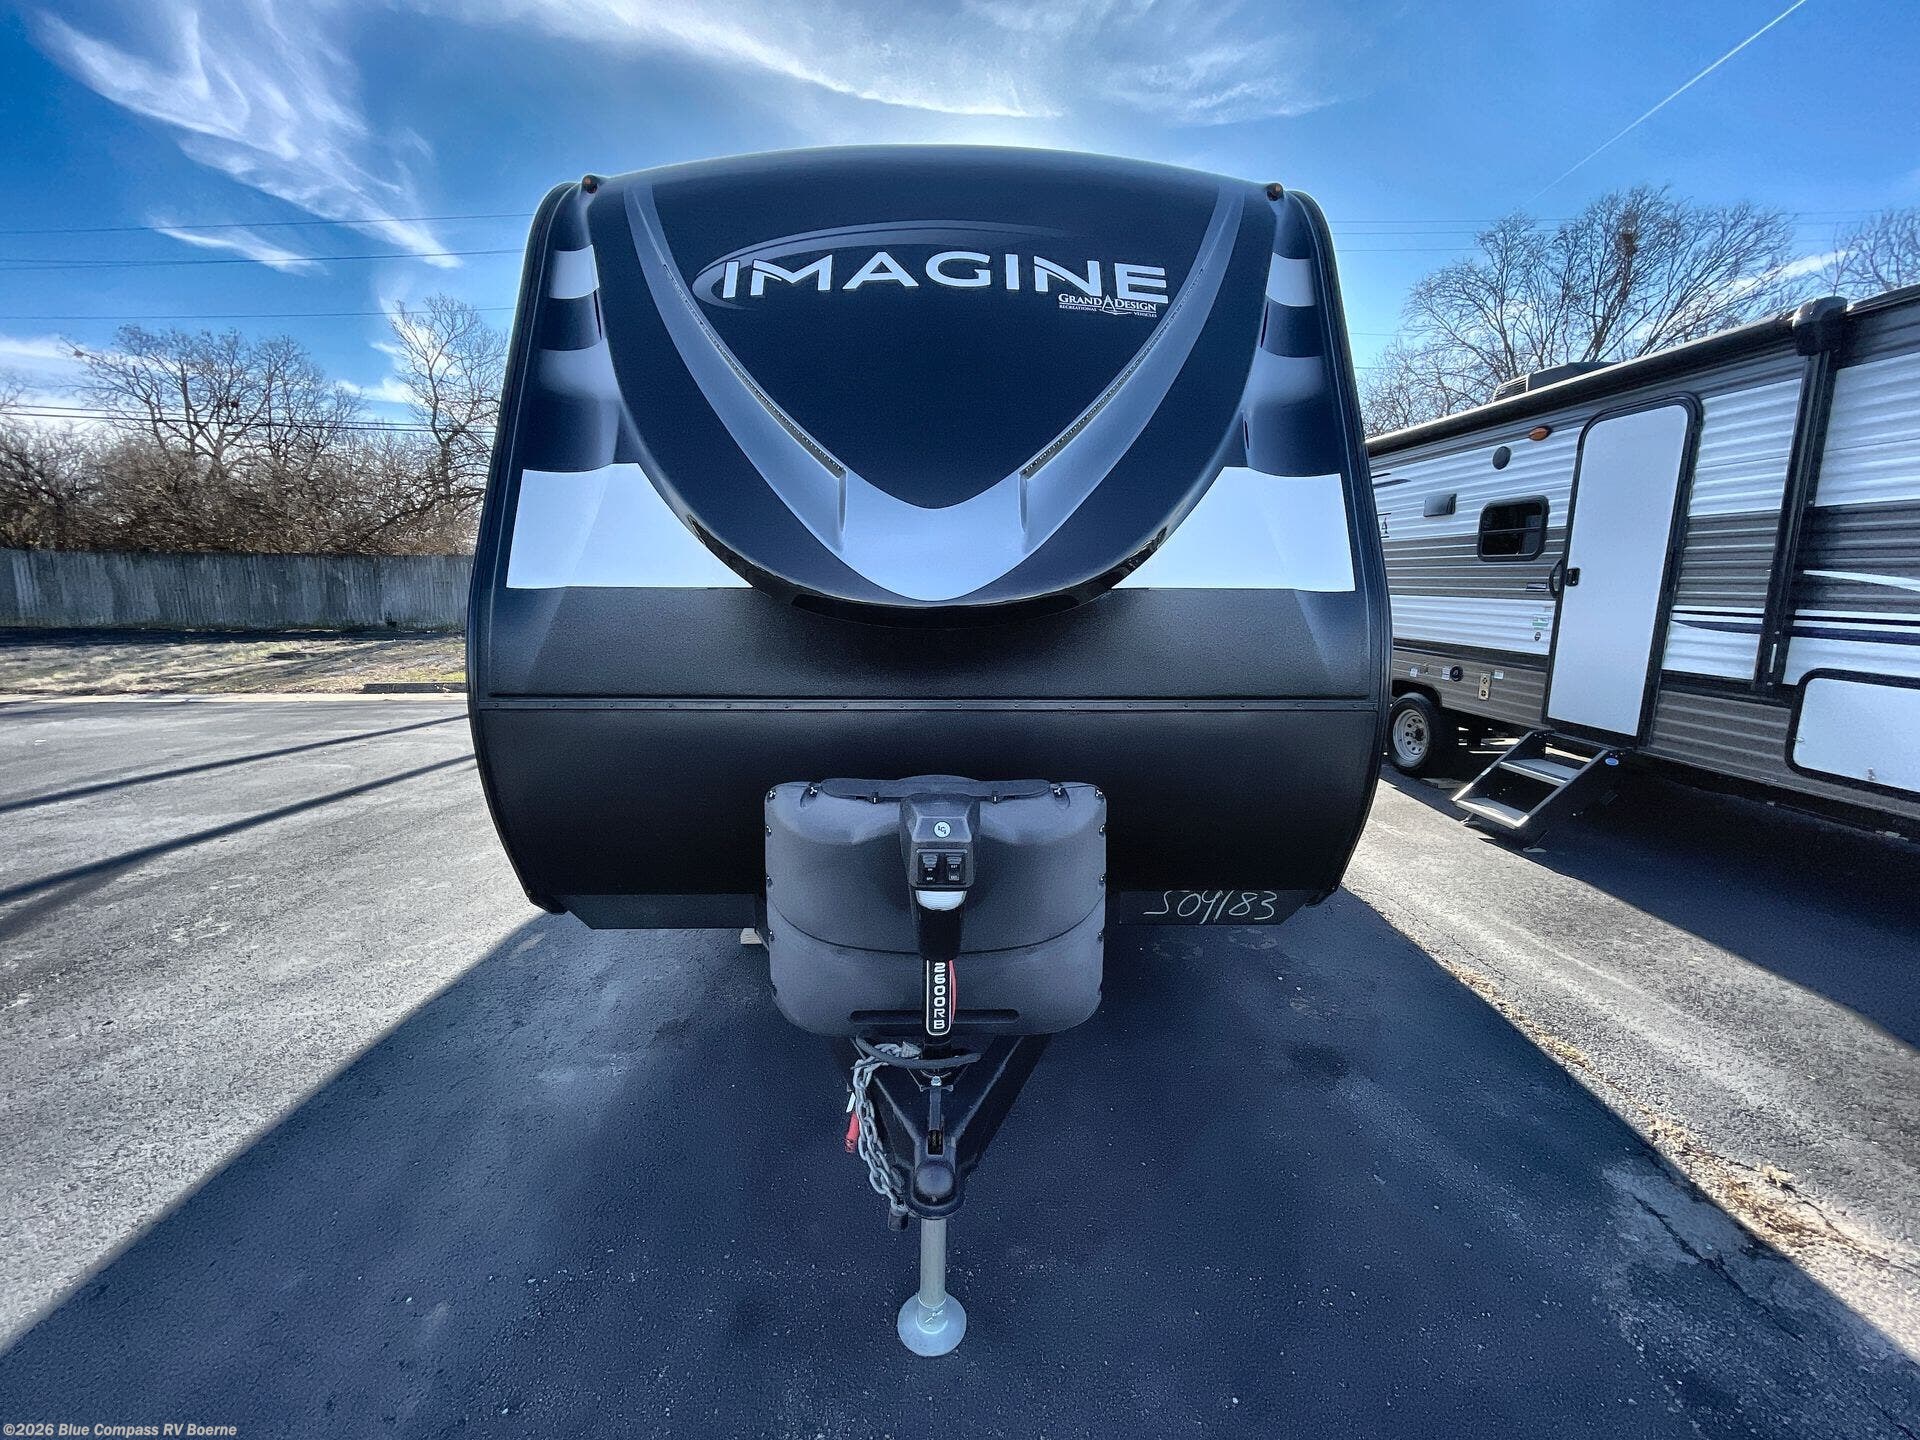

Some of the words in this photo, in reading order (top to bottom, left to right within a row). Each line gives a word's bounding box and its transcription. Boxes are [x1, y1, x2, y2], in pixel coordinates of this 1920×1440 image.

[722, 251, 1169, 304] IMAGINE
[1058, 294, 1102, 306] GRAND
[1115, 299, 1157, 312] DESIGN
[934, 962, 946, 1029] 2600RB
